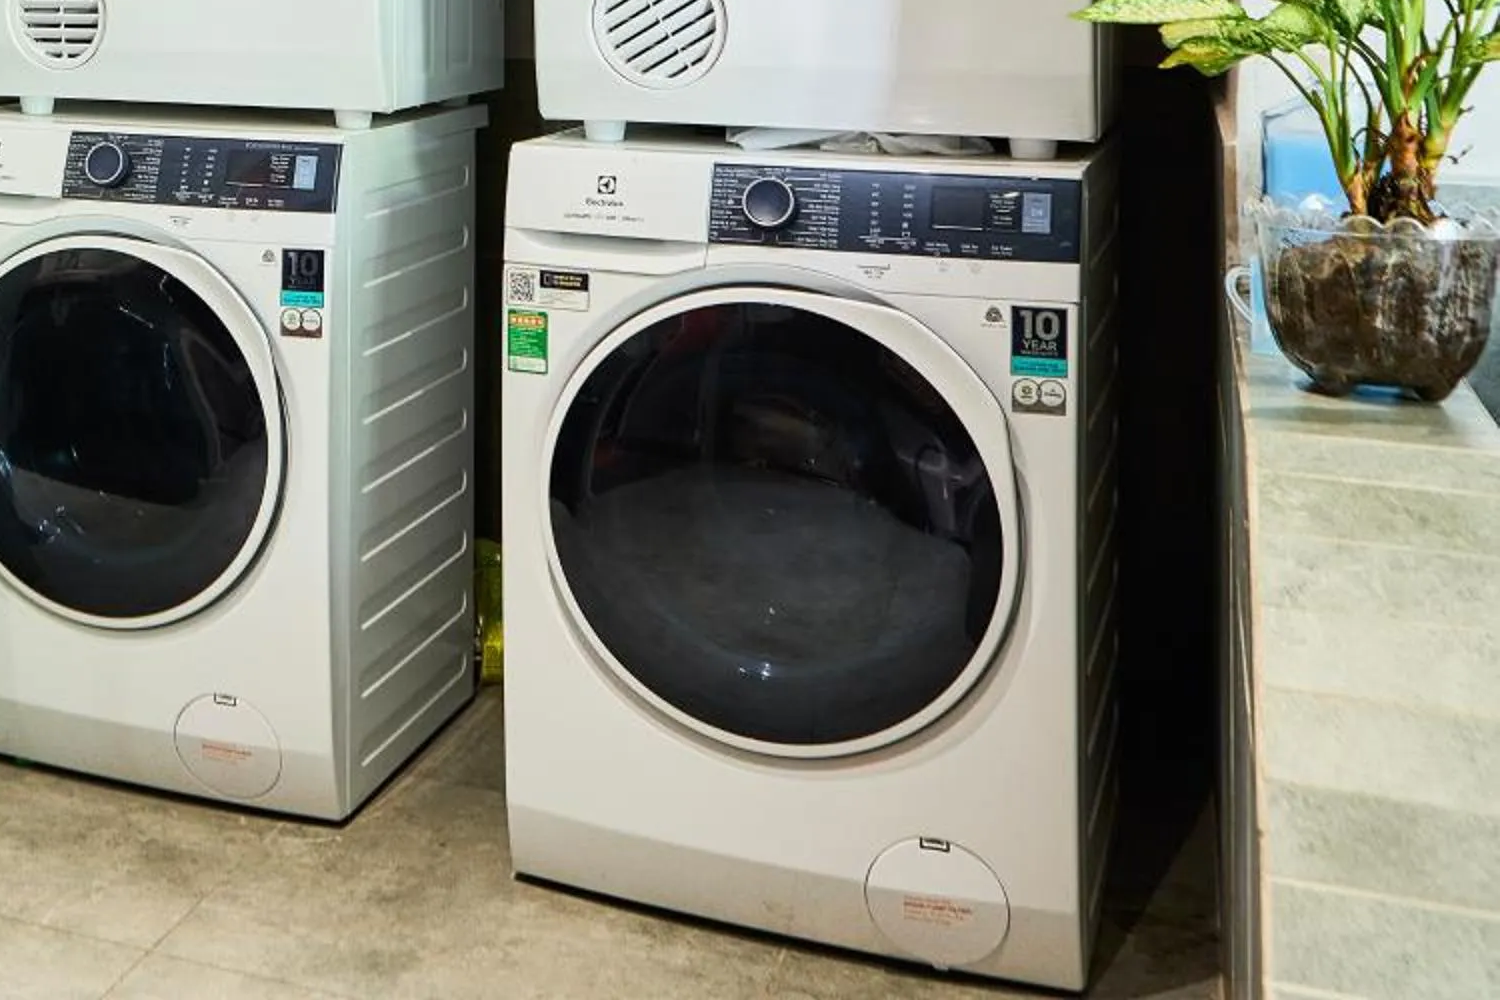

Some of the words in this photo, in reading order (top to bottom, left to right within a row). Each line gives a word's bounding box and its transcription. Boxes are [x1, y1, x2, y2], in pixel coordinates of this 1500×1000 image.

[287, 251, 319, 276] 10
[1020, 310, 1059, 340] 10
[1022, 339, 1057, 350] YEAR
